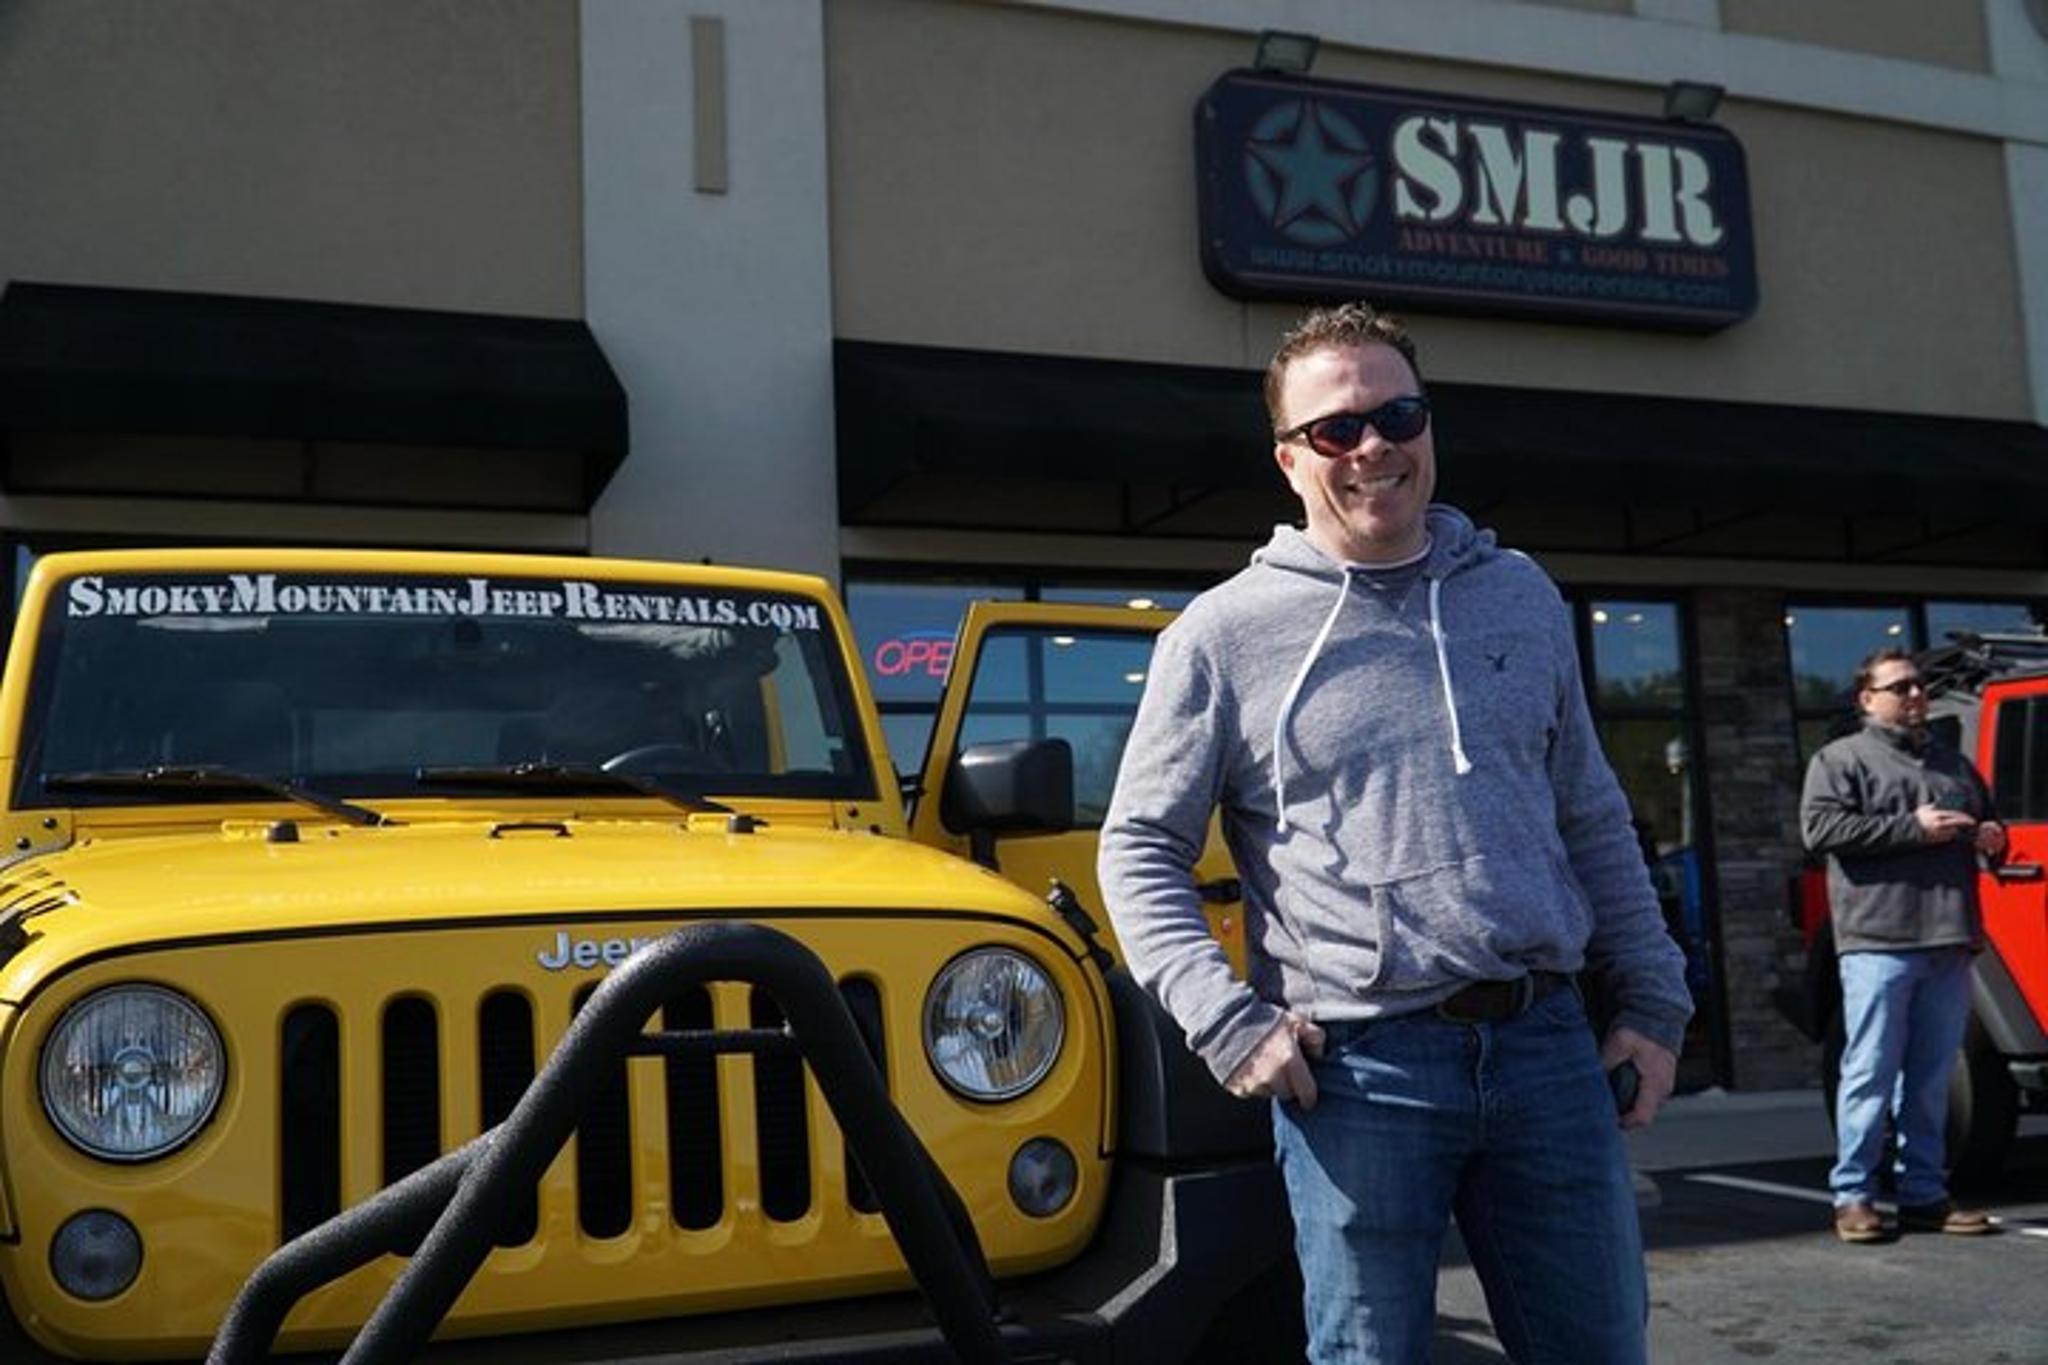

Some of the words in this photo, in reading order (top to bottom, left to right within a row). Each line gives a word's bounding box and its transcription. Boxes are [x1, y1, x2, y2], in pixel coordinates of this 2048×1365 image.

[1392, 115, 1723, 246] SMJR
[1399, 228, 1549, 263] ADVENTURE
[1582, 246, 1648, 274] GOOD
[1655, 252, 1730, 278] TIMES
[874, 639, 957, 677] OPE
